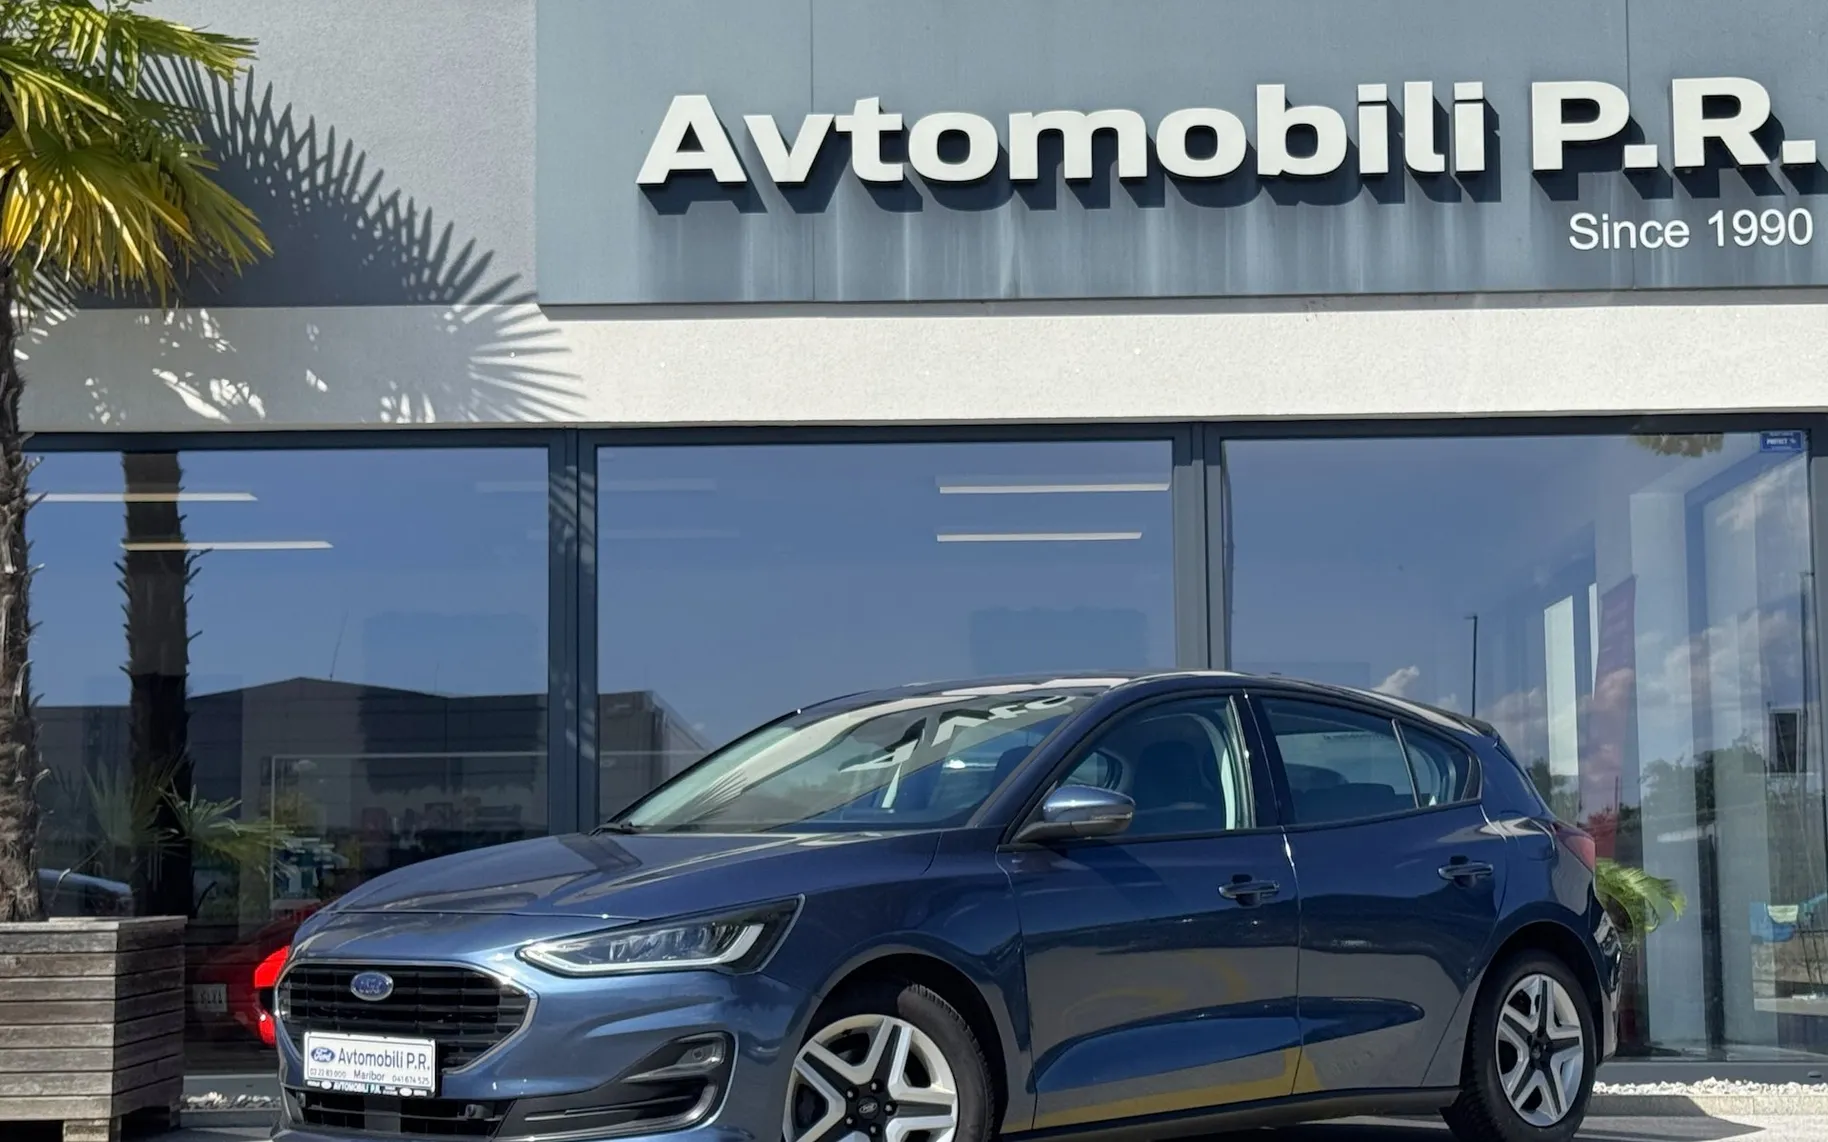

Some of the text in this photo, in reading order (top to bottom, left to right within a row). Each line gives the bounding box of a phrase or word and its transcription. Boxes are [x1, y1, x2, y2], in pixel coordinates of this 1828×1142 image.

[636, 76, 1816, 184] Avtomobili P.R.
[1568, 208, 1814, 251] Since 1990
[338, 1047, 403, 1069] Avtomobili
[406, 1052, 430, 1071] P.R.
[353, 1069, 385, 1081] Maribor
